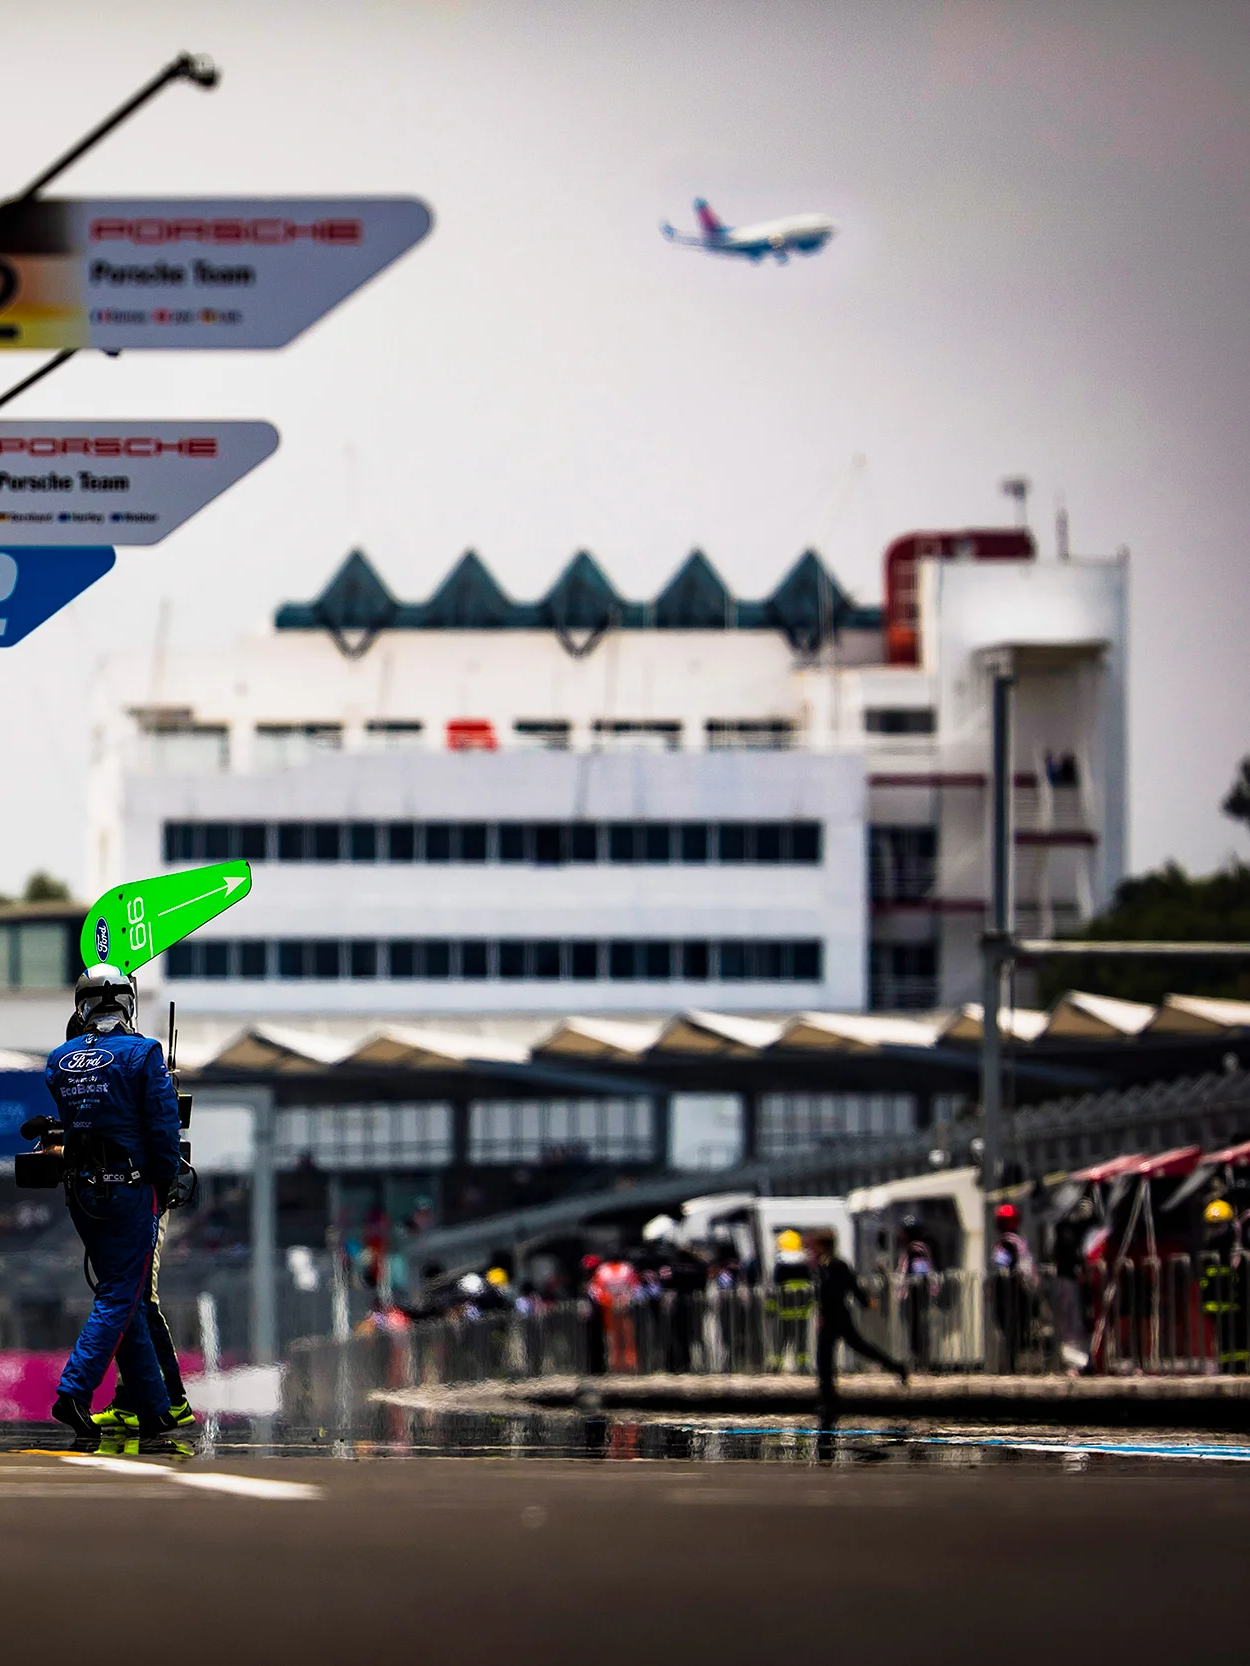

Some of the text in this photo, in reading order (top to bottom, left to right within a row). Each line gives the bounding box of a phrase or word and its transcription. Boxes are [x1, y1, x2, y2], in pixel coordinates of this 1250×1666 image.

[89, 218, 363, 246] PORSCHE
[90, 259, 256, 286] Porsche Team
[80, 471, 130, 493] Team
[126, 896, 147, 951] 66
[96, 925, 108, 953] Ford
[67, 1050, 104, 1069] Ford
